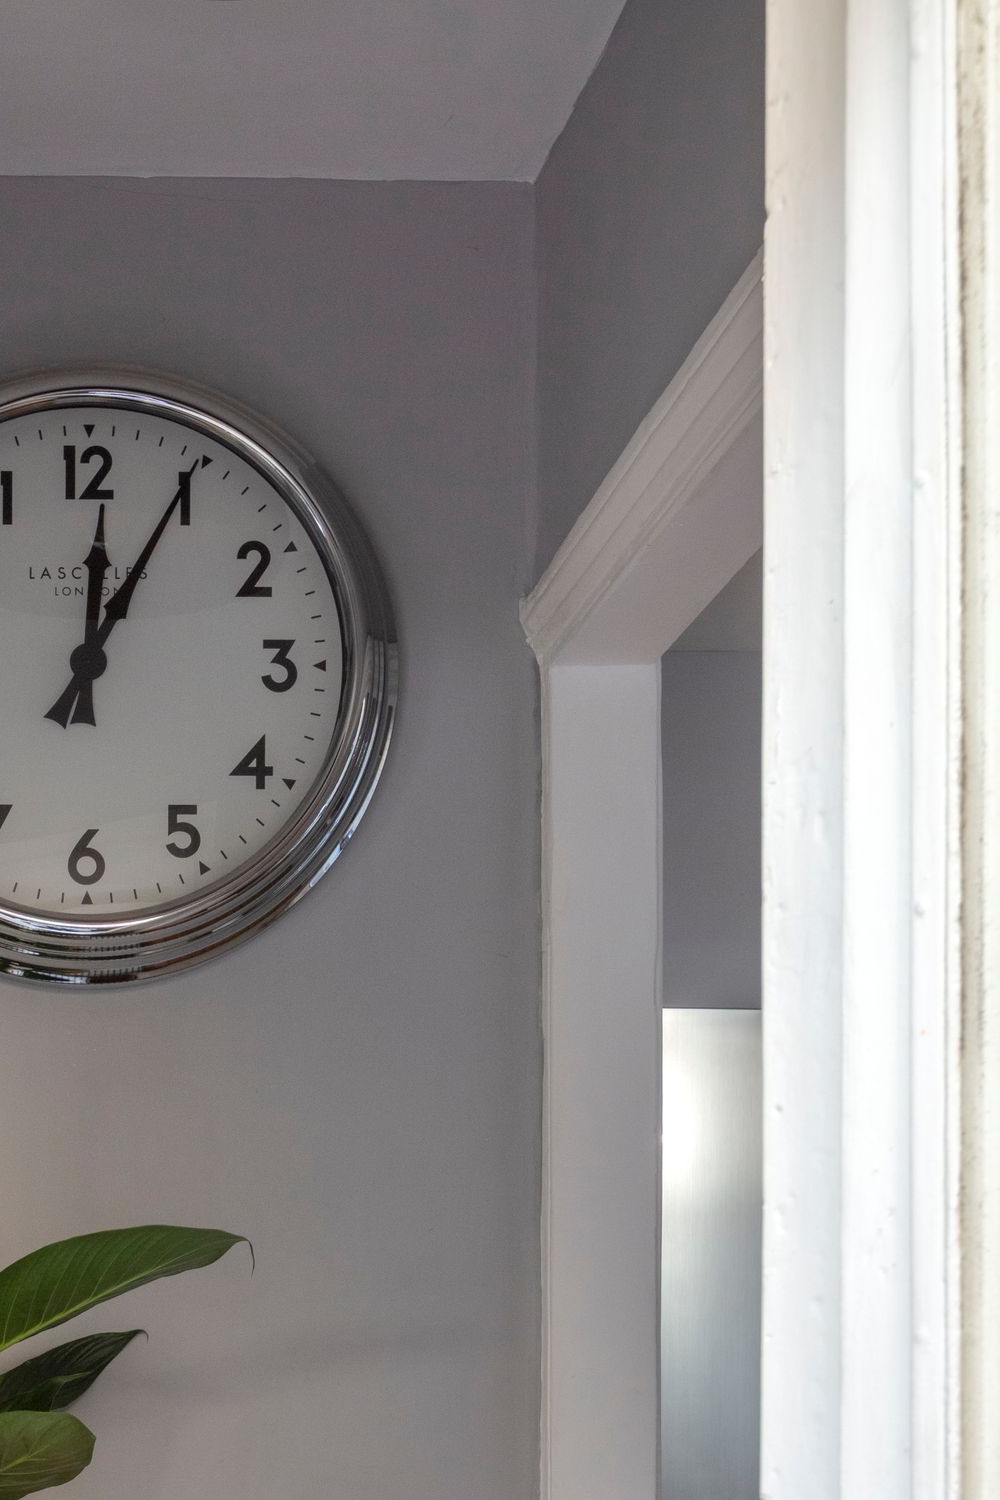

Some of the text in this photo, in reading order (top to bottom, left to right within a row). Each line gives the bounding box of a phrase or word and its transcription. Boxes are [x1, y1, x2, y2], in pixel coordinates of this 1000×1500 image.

[63, 445, 114, 500] 12
[179, 471, 191, 526] 1
[29, 566, 148, 580] LASCLES
[55, 586, 123, 597] LONO
[235, 540, 273, 597] 2
[261, 639, 298, 693] 3
[229, 734, 273, 790] 4
[67, 829, 106, 885] 6
[166, 804, 201, 858] 5
